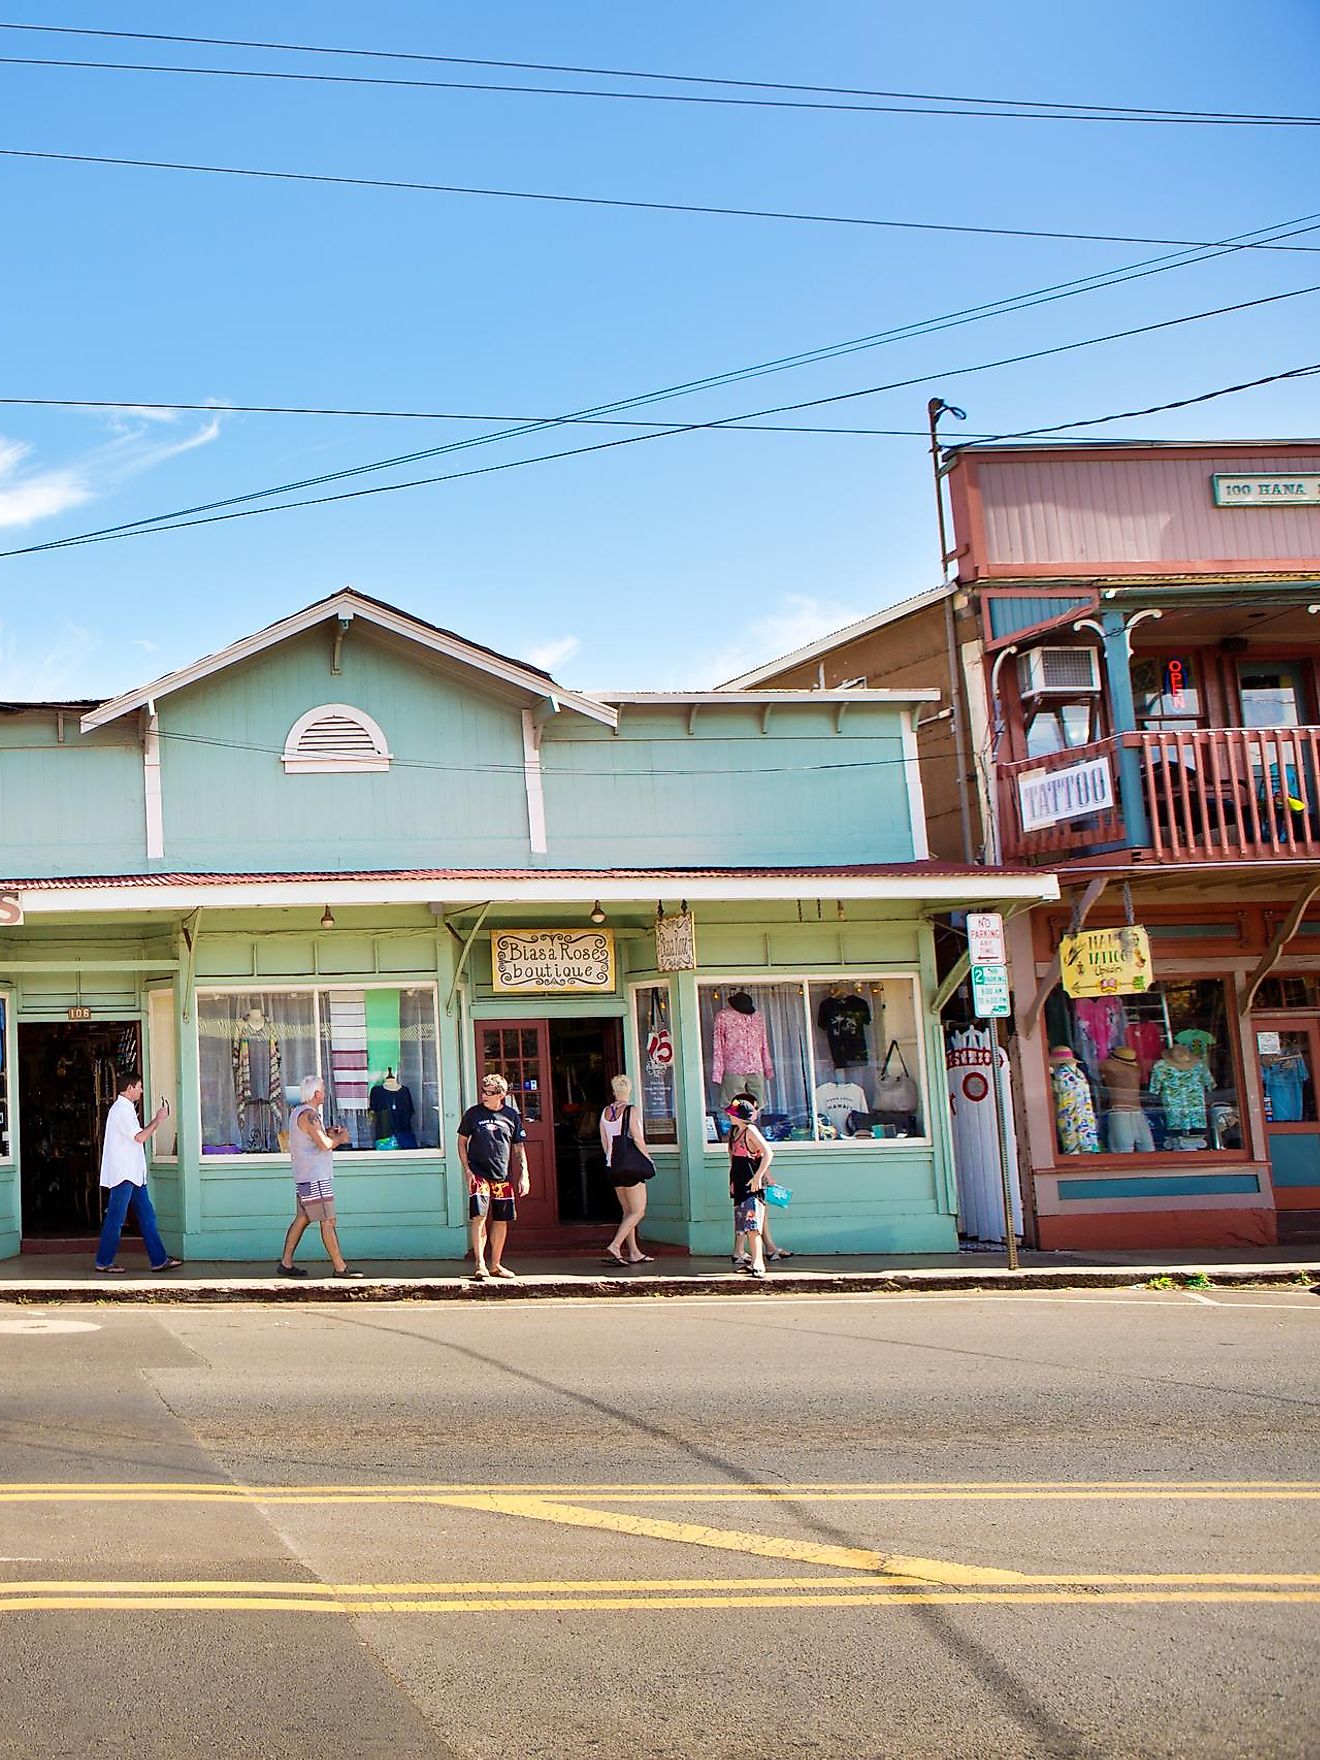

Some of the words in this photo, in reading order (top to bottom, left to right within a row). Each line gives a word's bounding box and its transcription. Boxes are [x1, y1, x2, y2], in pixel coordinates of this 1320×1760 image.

[1226, 484, 1251, 496] 100
[1258, 484, 1306, 496] HANA
[1169, 660, 1185, 708] OPEN
[1024, 767, 1106, 820] TATTOO
[509, 942, 557, 961] Biasa
[559, 942, 601, 961] Rose
[513, 963, 593, 978] boutique
[71, 1009, 89, 1018] 106
